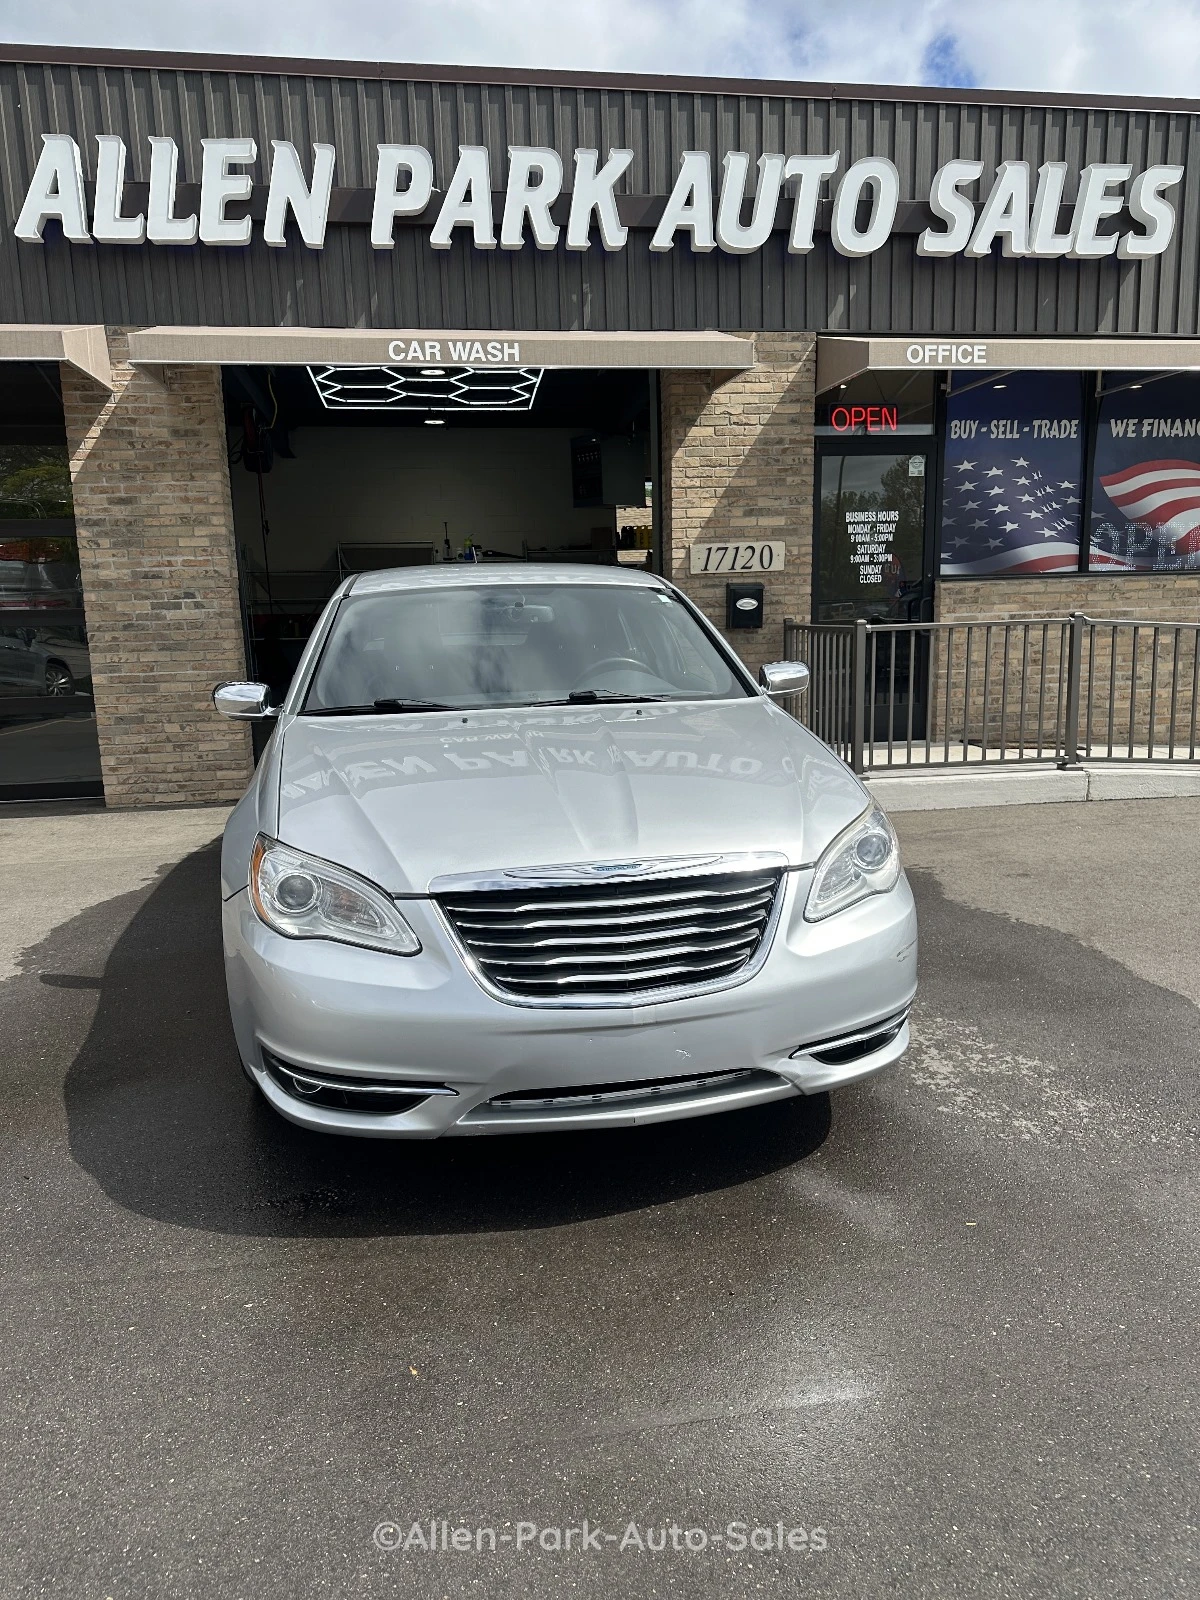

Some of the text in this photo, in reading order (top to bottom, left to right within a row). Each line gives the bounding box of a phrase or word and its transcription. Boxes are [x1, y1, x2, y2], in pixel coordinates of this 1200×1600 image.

[14, 133, 1184, 259] ALLEN PARK AUTO SALES
[388, 340, 520, 362] CAR WASH
[906, 344, 987, 364] OFFICE
[831, 407, 897, 432] OPEN
[950, 419, 979, 440] BUY
[990, 419, 1020, 439] SELL
[1033, 419, 1079, 439] TRADE
[1110, 418, 1139, 438] WE
[845, 511, 899, 522] BUSINESS HOURS
[847, 523, 871, 533] MONDAY
[876, 522, 896, 533] FRIDAY
[700, 544, 773, 571] 17120
[857, 544, 886, 554] SATURDAY
[859, 564, 882, 575] SUNDAY
[859, 574, 882, 584] CLOSED
